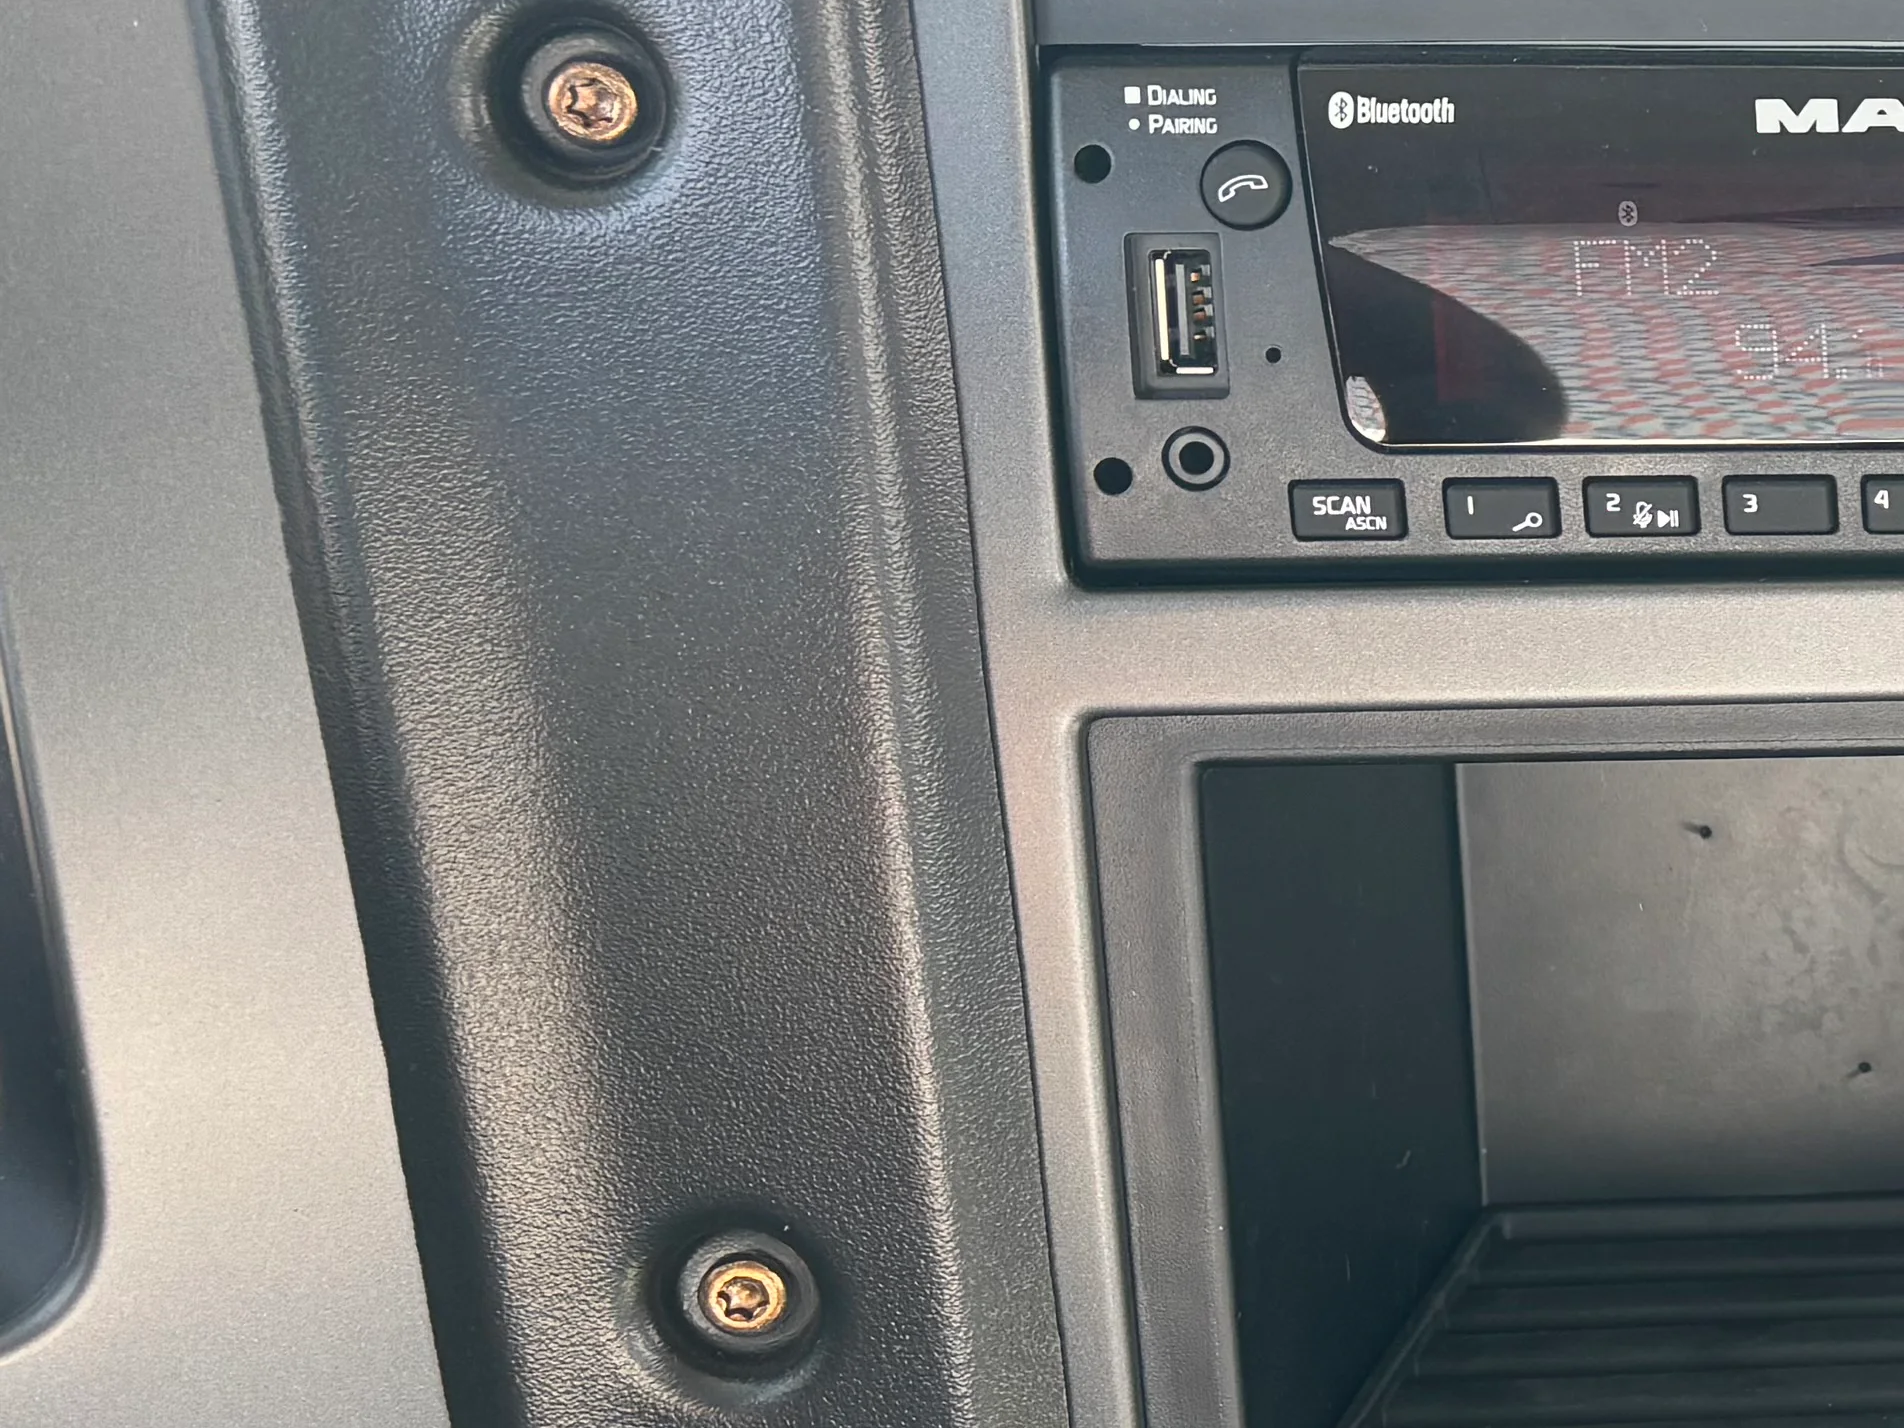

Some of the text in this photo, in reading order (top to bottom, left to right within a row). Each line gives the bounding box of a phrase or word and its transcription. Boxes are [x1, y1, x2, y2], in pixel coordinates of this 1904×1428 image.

[1147, 84, 1217, 106] DIALING
[1356, 95, 1455, 124] Bluetooth
[1148, 113, 1218, 135] PAIRING
[1572, 237, 1720, 297] FM2
[1312, 495, 1372, 516] SCAN
[1467, 495, 1474, 515] 1
[1605, 492, 1621, 512] 2
[1742, 493, 1759, 513] 3
[1873, 489, 1890, 509] 4
[1345, 515, 1388, 531] ASCN
